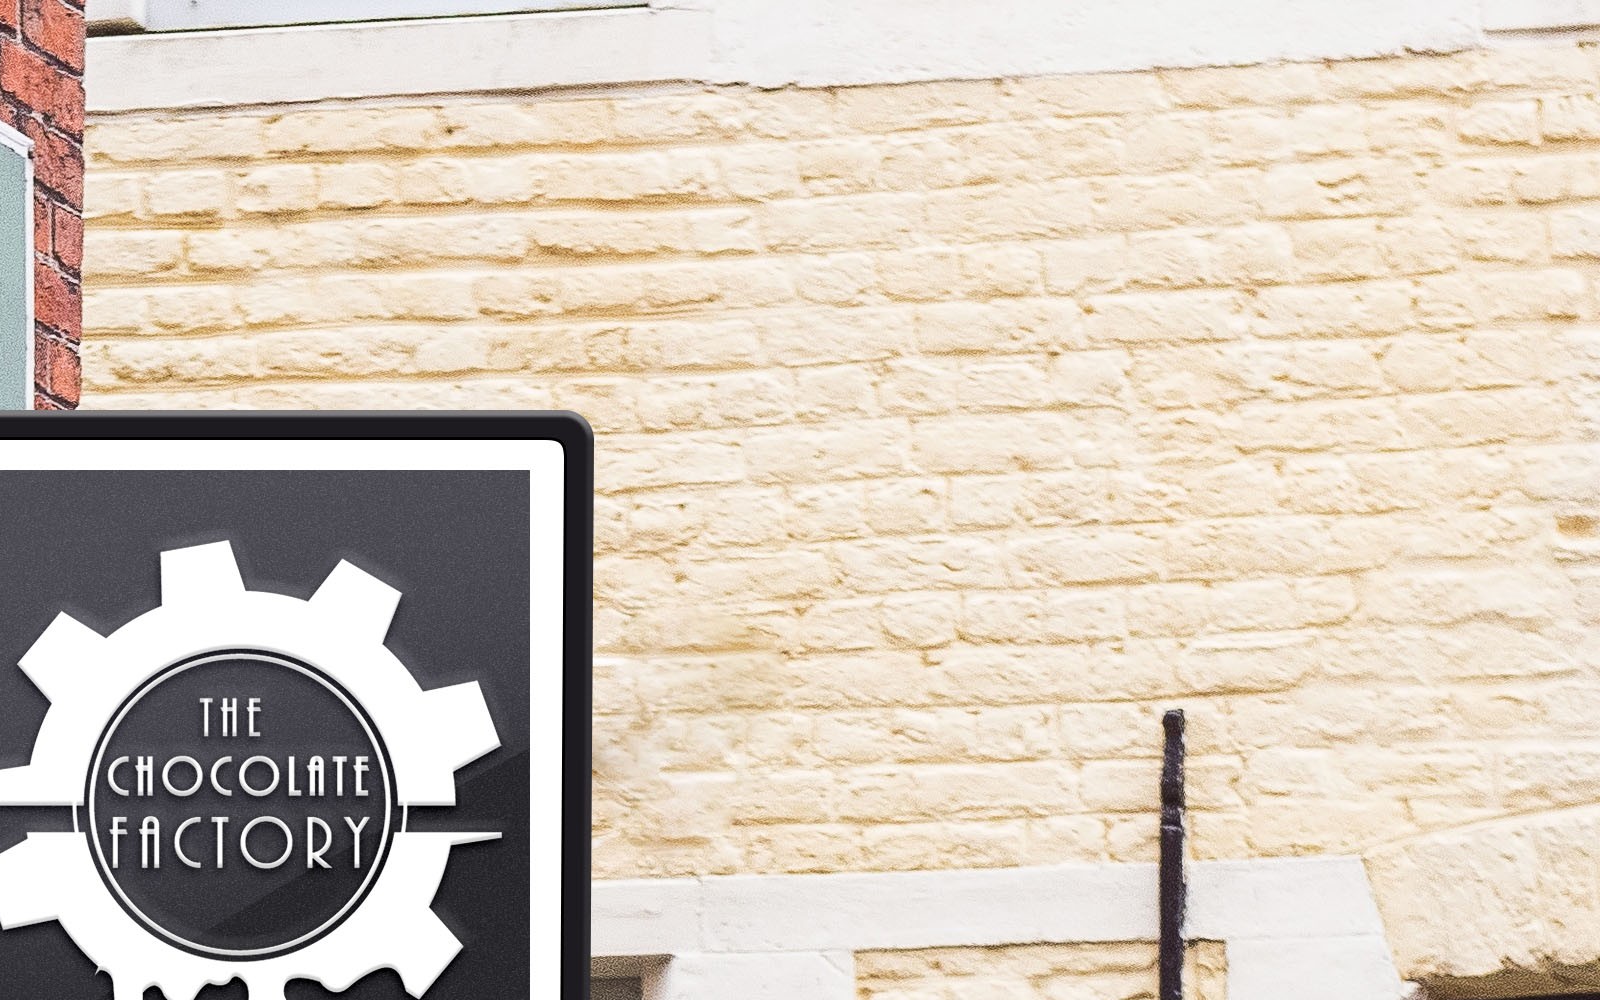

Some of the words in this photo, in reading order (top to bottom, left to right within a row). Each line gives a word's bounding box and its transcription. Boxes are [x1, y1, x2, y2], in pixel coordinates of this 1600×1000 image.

[199, 697, 262, 737] THE
[107, 755, 370, 797] CHOCOLATE
[109, 815, 371, 869] FACTORY
